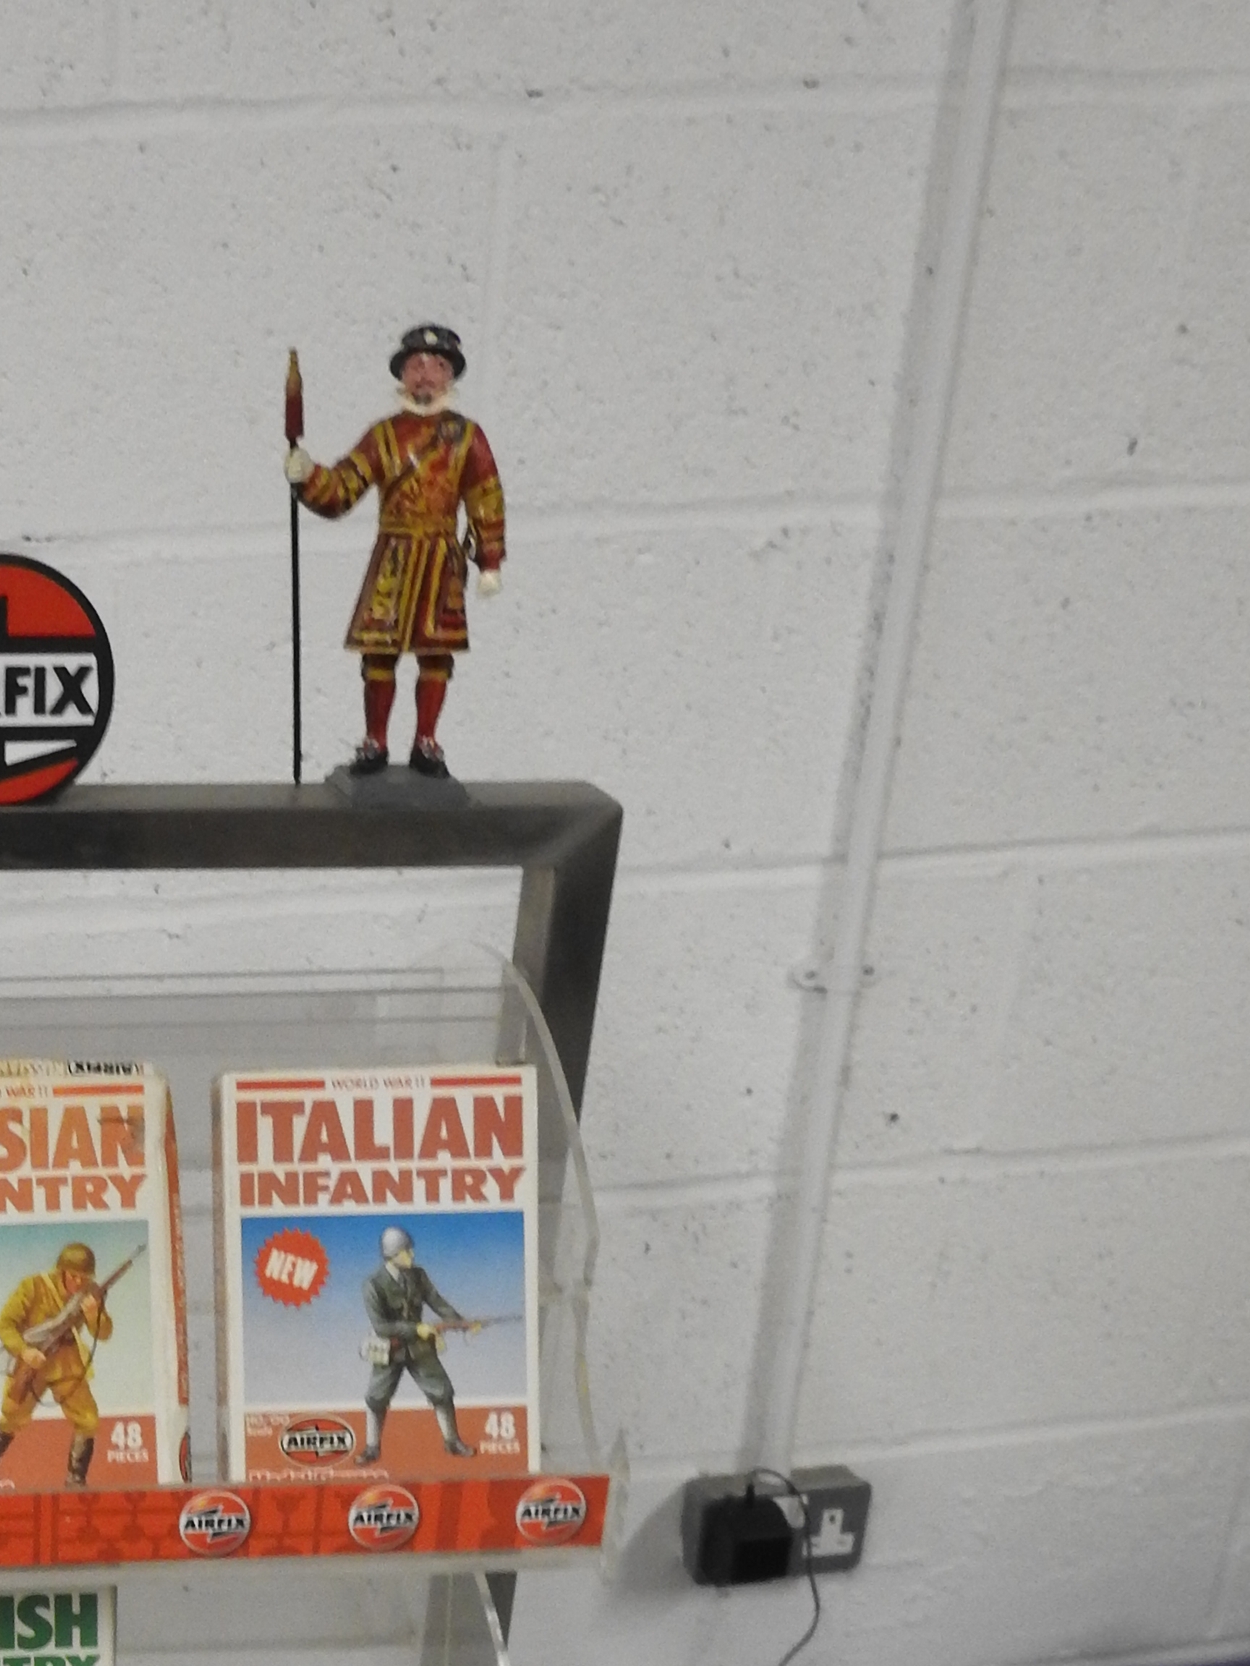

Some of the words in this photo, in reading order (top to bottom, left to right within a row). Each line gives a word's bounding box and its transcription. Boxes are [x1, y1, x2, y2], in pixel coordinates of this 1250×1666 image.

[5, 1083, 36, 1098] WAR
[330, 1077, 379, 1091] WORLD
[382, 1076, 413, 1090] WAR
[236, 1096, 523, 1163] ITALIAN
[240, 1167, 525, 1207] INFANTRY
[264, 1247, 319, 1291] NEW
[484, 1411, 516, 1440] 48
[111, 1420, 143, 1450] 48
[287, 1435, 347, 1449] AIRFIX
[479, 1440, 520, 1455] PIECES
[107, 1449, 149, 1463] PIECES
[352, 1510, 416, 1526] AIRFIX
[520, 1504, 582, 1521] AIRFIX
[184, 1515, 246, 1531] AIRFIX
